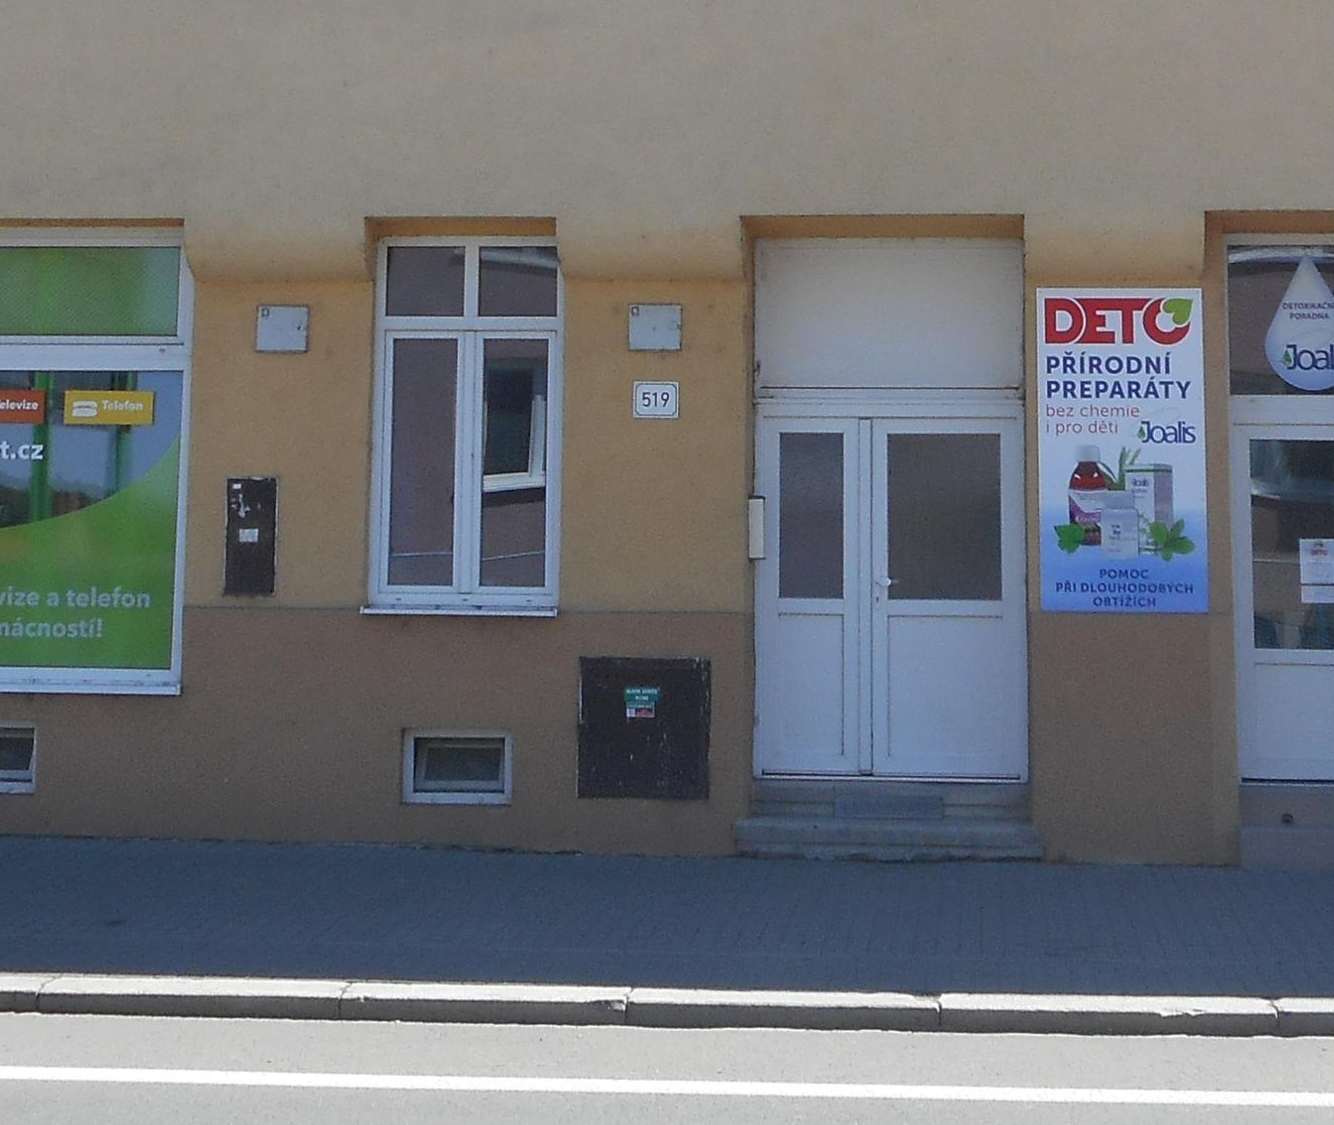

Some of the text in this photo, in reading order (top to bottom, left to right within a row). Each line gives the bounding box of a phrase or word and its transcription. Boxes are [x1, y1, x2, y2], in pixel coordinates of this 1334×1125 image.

[1043, 296, 1193, 346] DETO
[1046, 351, 1172, 375] PŘÍRODNÍ
[1046, 376, 1192, 400] PREPARÁTY
[102, 398, 145, 412] Telefon
[642, 391, 670, 407] 519
[1046, 404, 1140, 418] bez chemie
[1055, 424, 1083, 436] pro
[1088, 420, 1119, 434] děti
[1140, 420, 1197, 444] Joalis
[1099, 569, 1149, 580] POMOC
[1055, 581, 1076, 593] PŘI
[47, 592, 60, 607] a
[66, 586, 151, 609] telefon
